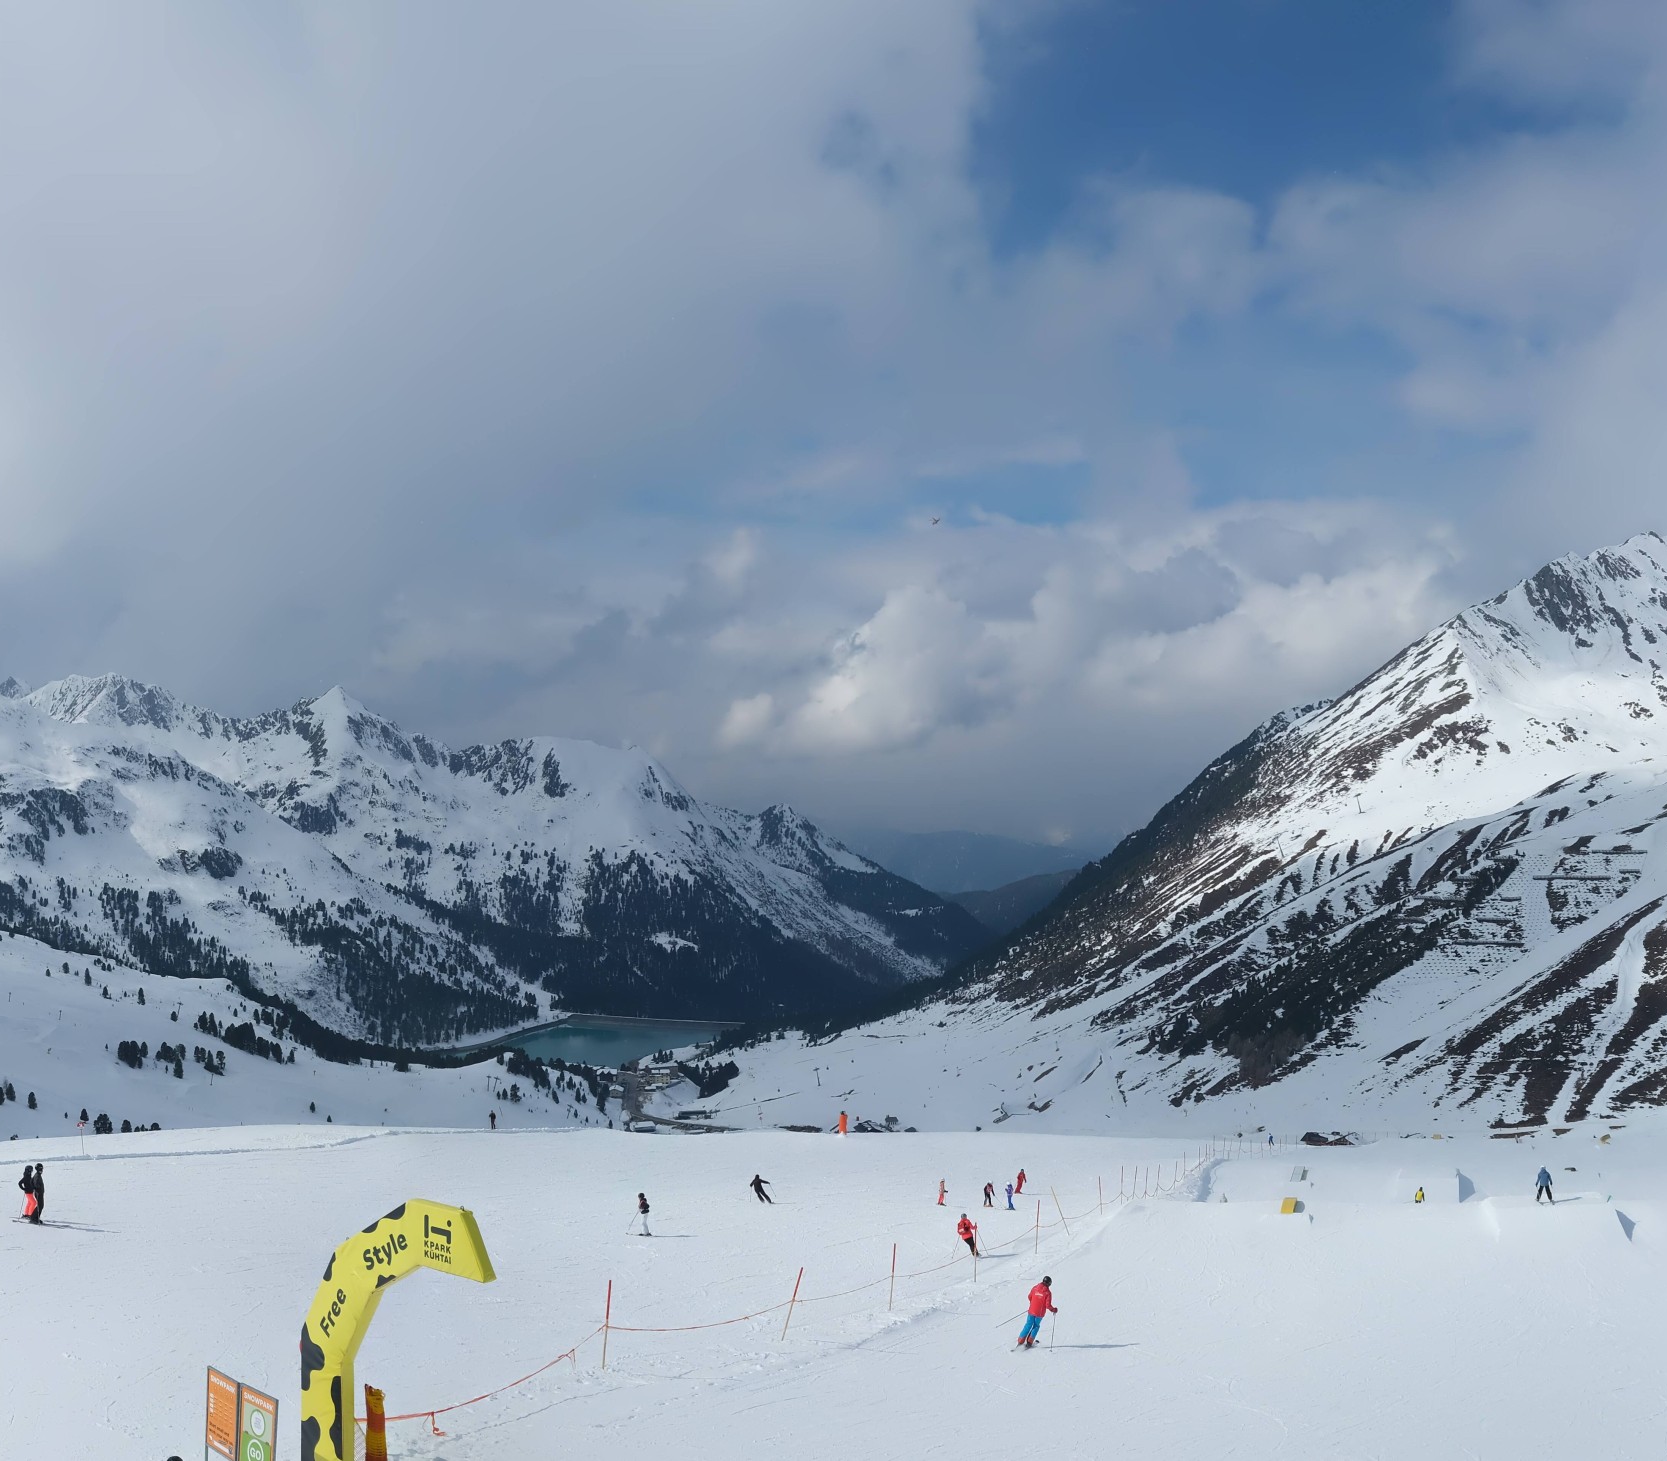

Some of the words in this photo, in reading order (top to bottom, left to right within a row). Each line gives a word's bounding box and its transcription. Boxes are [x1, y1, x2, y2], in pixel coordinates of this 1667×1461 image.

[424, 1240, 451, 1254] KPARK
[424, 1249, 451, 1264] KÜHTAI
[320, 1288, 346, 1338] Free
[363, 1233, 408, 1270] Style
[210, 1374, 235, 1393] SNOWPARK
[243, 1391, 273, 1410] SNOWPARK
[250, 1447, 261, 1460] GO
